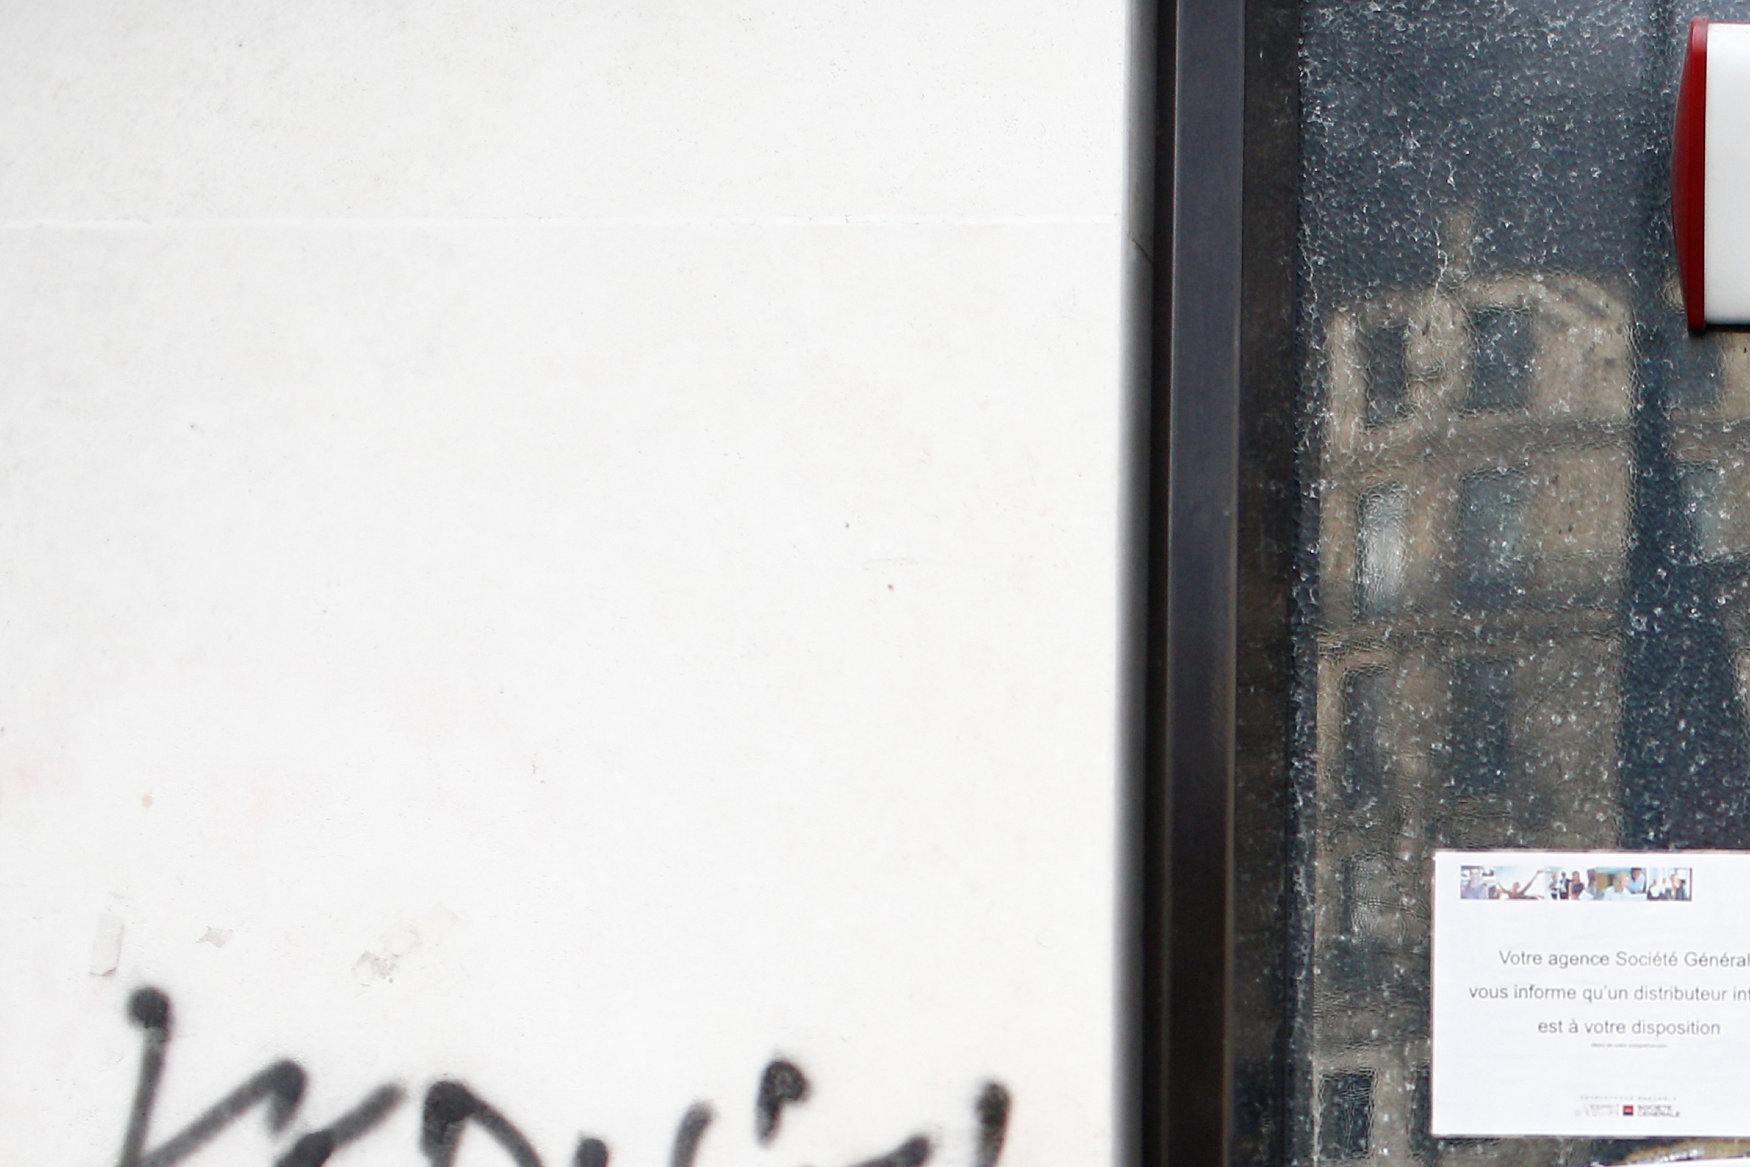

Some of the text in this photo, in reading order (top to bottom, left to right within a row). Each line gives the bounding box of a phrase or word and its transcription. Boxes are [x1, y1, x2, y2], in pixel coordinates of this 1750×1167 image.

[1499, 950, 1542, 966] Votre
[1548, 953, 1610, 969] agence
[1616, 950, 1678, 967] Société
[1469, 987, 1508, 999] vous
[1514, 984, 1576, 1000] informe
[1583, 985, 1628, 1002] qu'un
[1634, 985, 1727, 1001] distributeur
[1538, 1019, 1721, 1037] est à votre disposition
